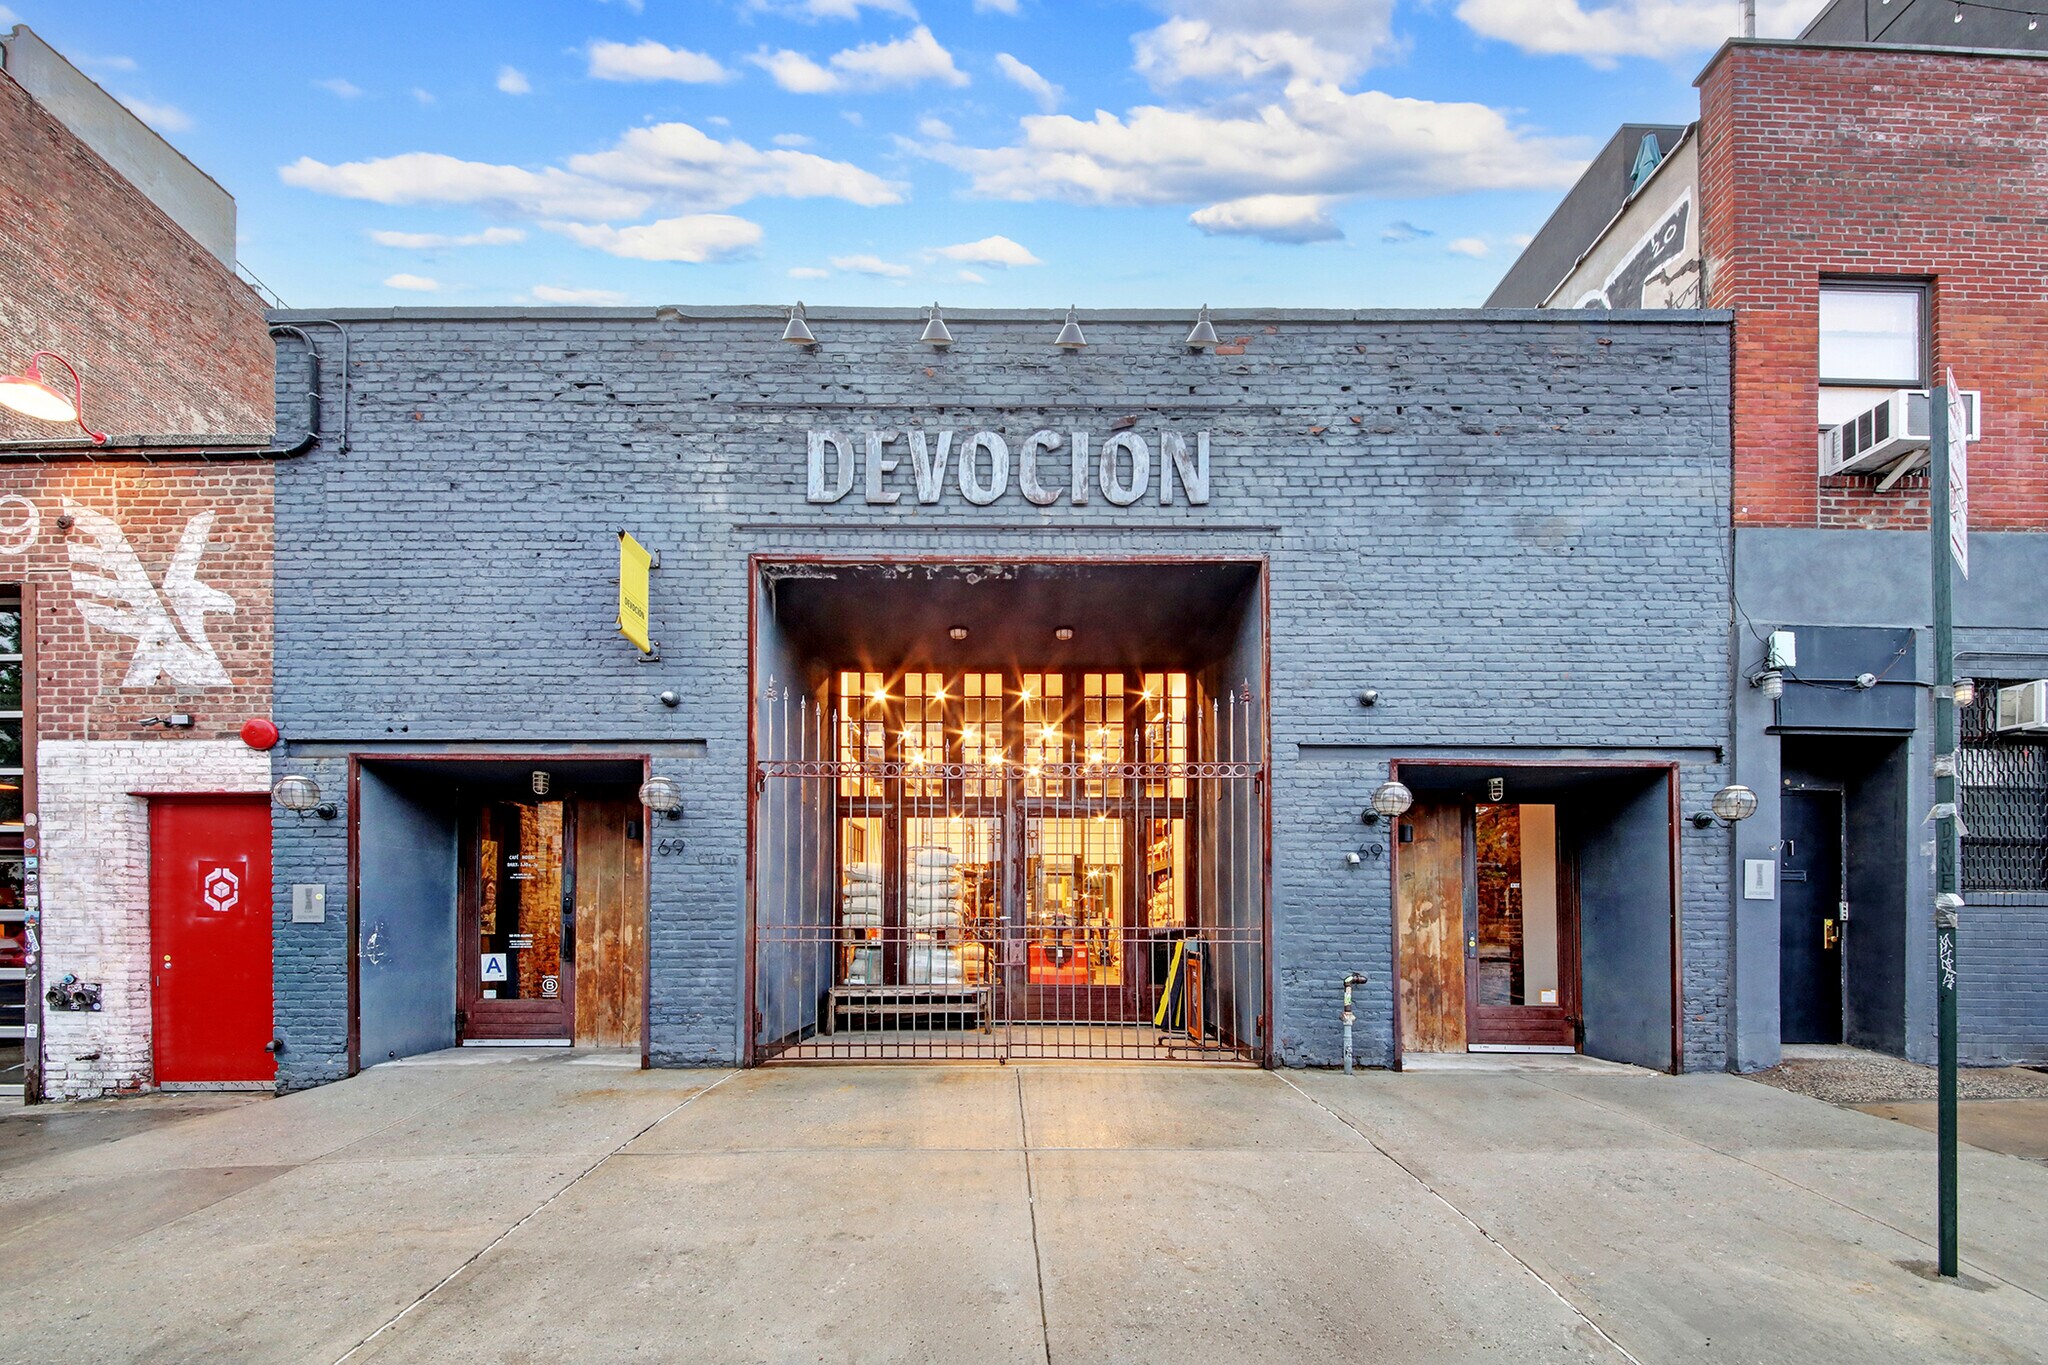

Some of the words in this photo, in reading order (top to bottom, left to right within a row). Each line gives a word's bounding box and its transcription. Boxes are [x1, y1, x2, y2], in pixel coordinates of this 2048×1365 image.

[806, 414, 1210, 506] DEVOCIÓN
[658, 838, 686, 857] 69
[1357, 843, 1384, 861] 69
[1780, 840, 1794, 856] 71
[486, 957, 502, 973] A
